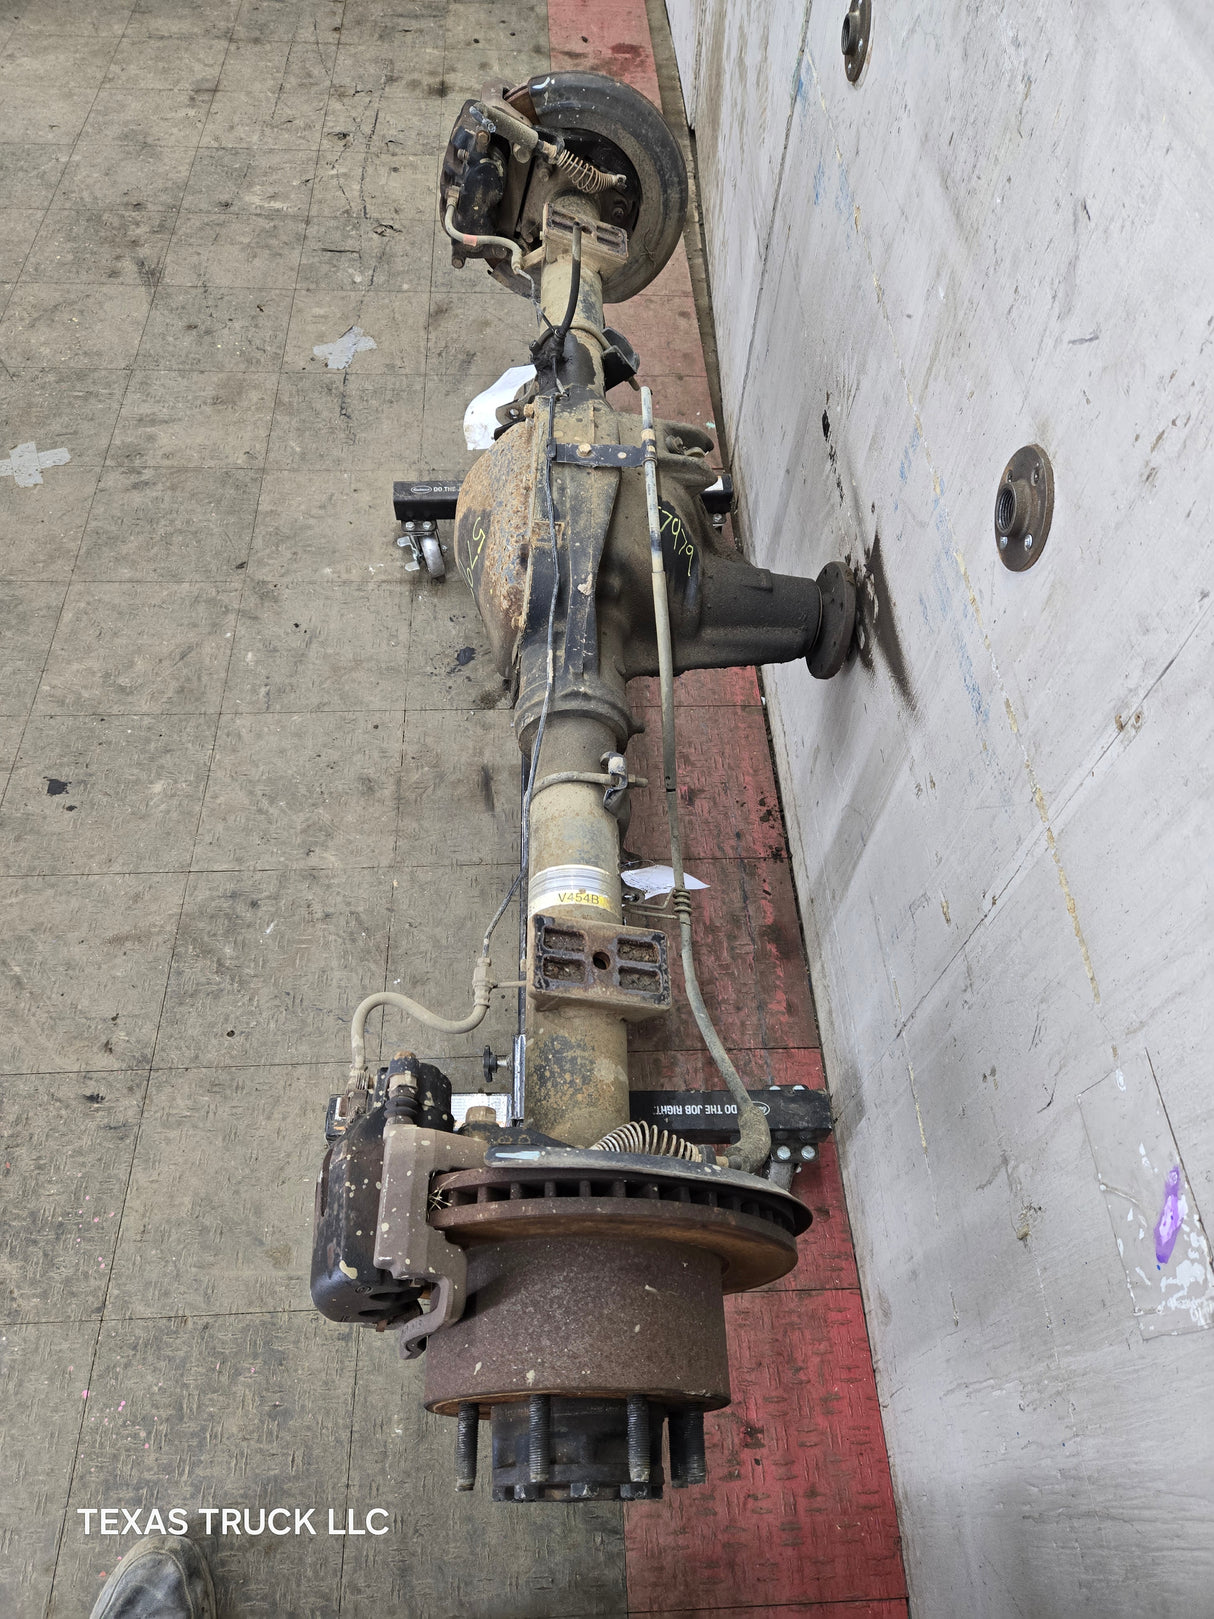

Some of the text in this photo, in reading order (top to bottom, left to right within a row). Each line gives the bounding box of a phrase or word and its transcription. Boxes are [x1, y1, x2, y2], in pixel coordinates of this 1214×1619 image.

[558, 892, 600, 905] V454B
[685, 1104, 703, 1115] JOB
[704, 1104, 722, 1114] THE
[724, 1104, 738, 1114] DO
